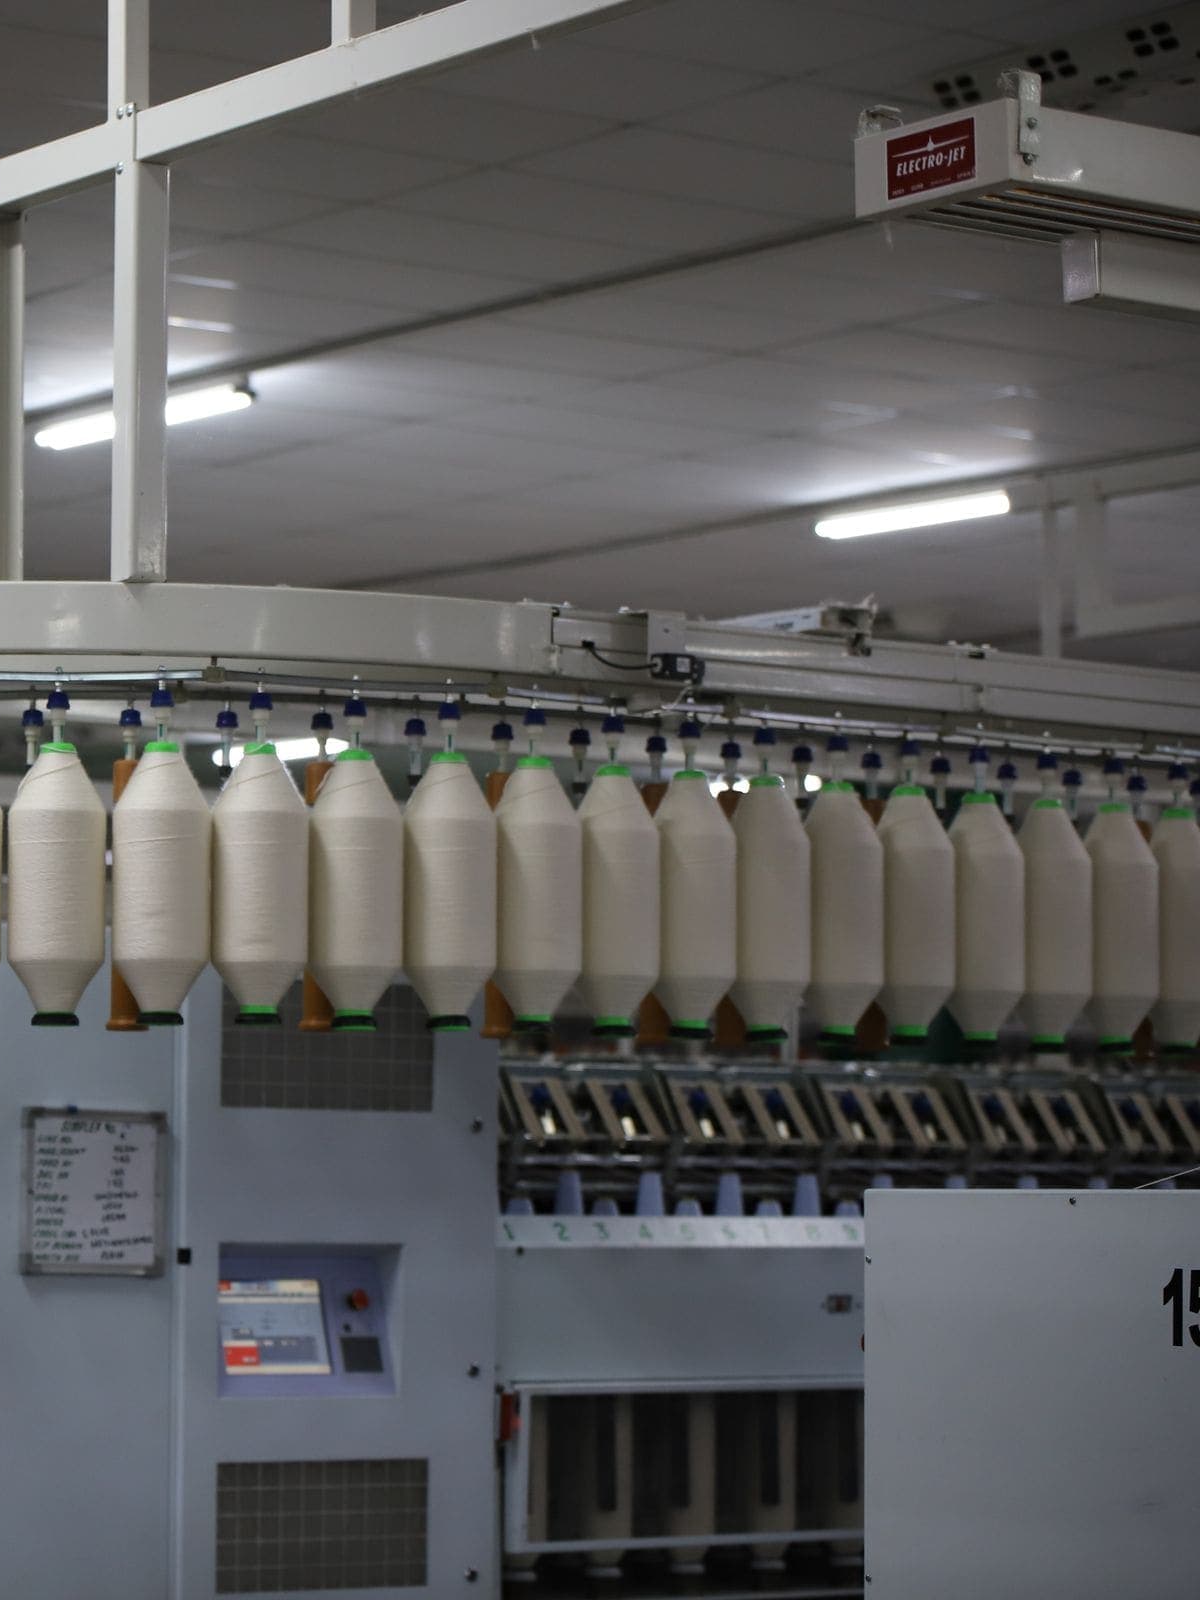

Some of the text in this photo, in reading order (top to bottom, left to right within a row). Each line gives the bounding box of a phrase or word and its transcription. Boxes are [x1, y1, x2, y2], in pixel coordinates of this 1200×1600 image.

[896, 146, 966, 176] ELECTRO-JET
[503, 1221, 515, 1241] 1
[552, 1221, 571, 1242] 2
[592, 1221, 610, 1240] 3
[638, 1222, 653, 1240] 4
